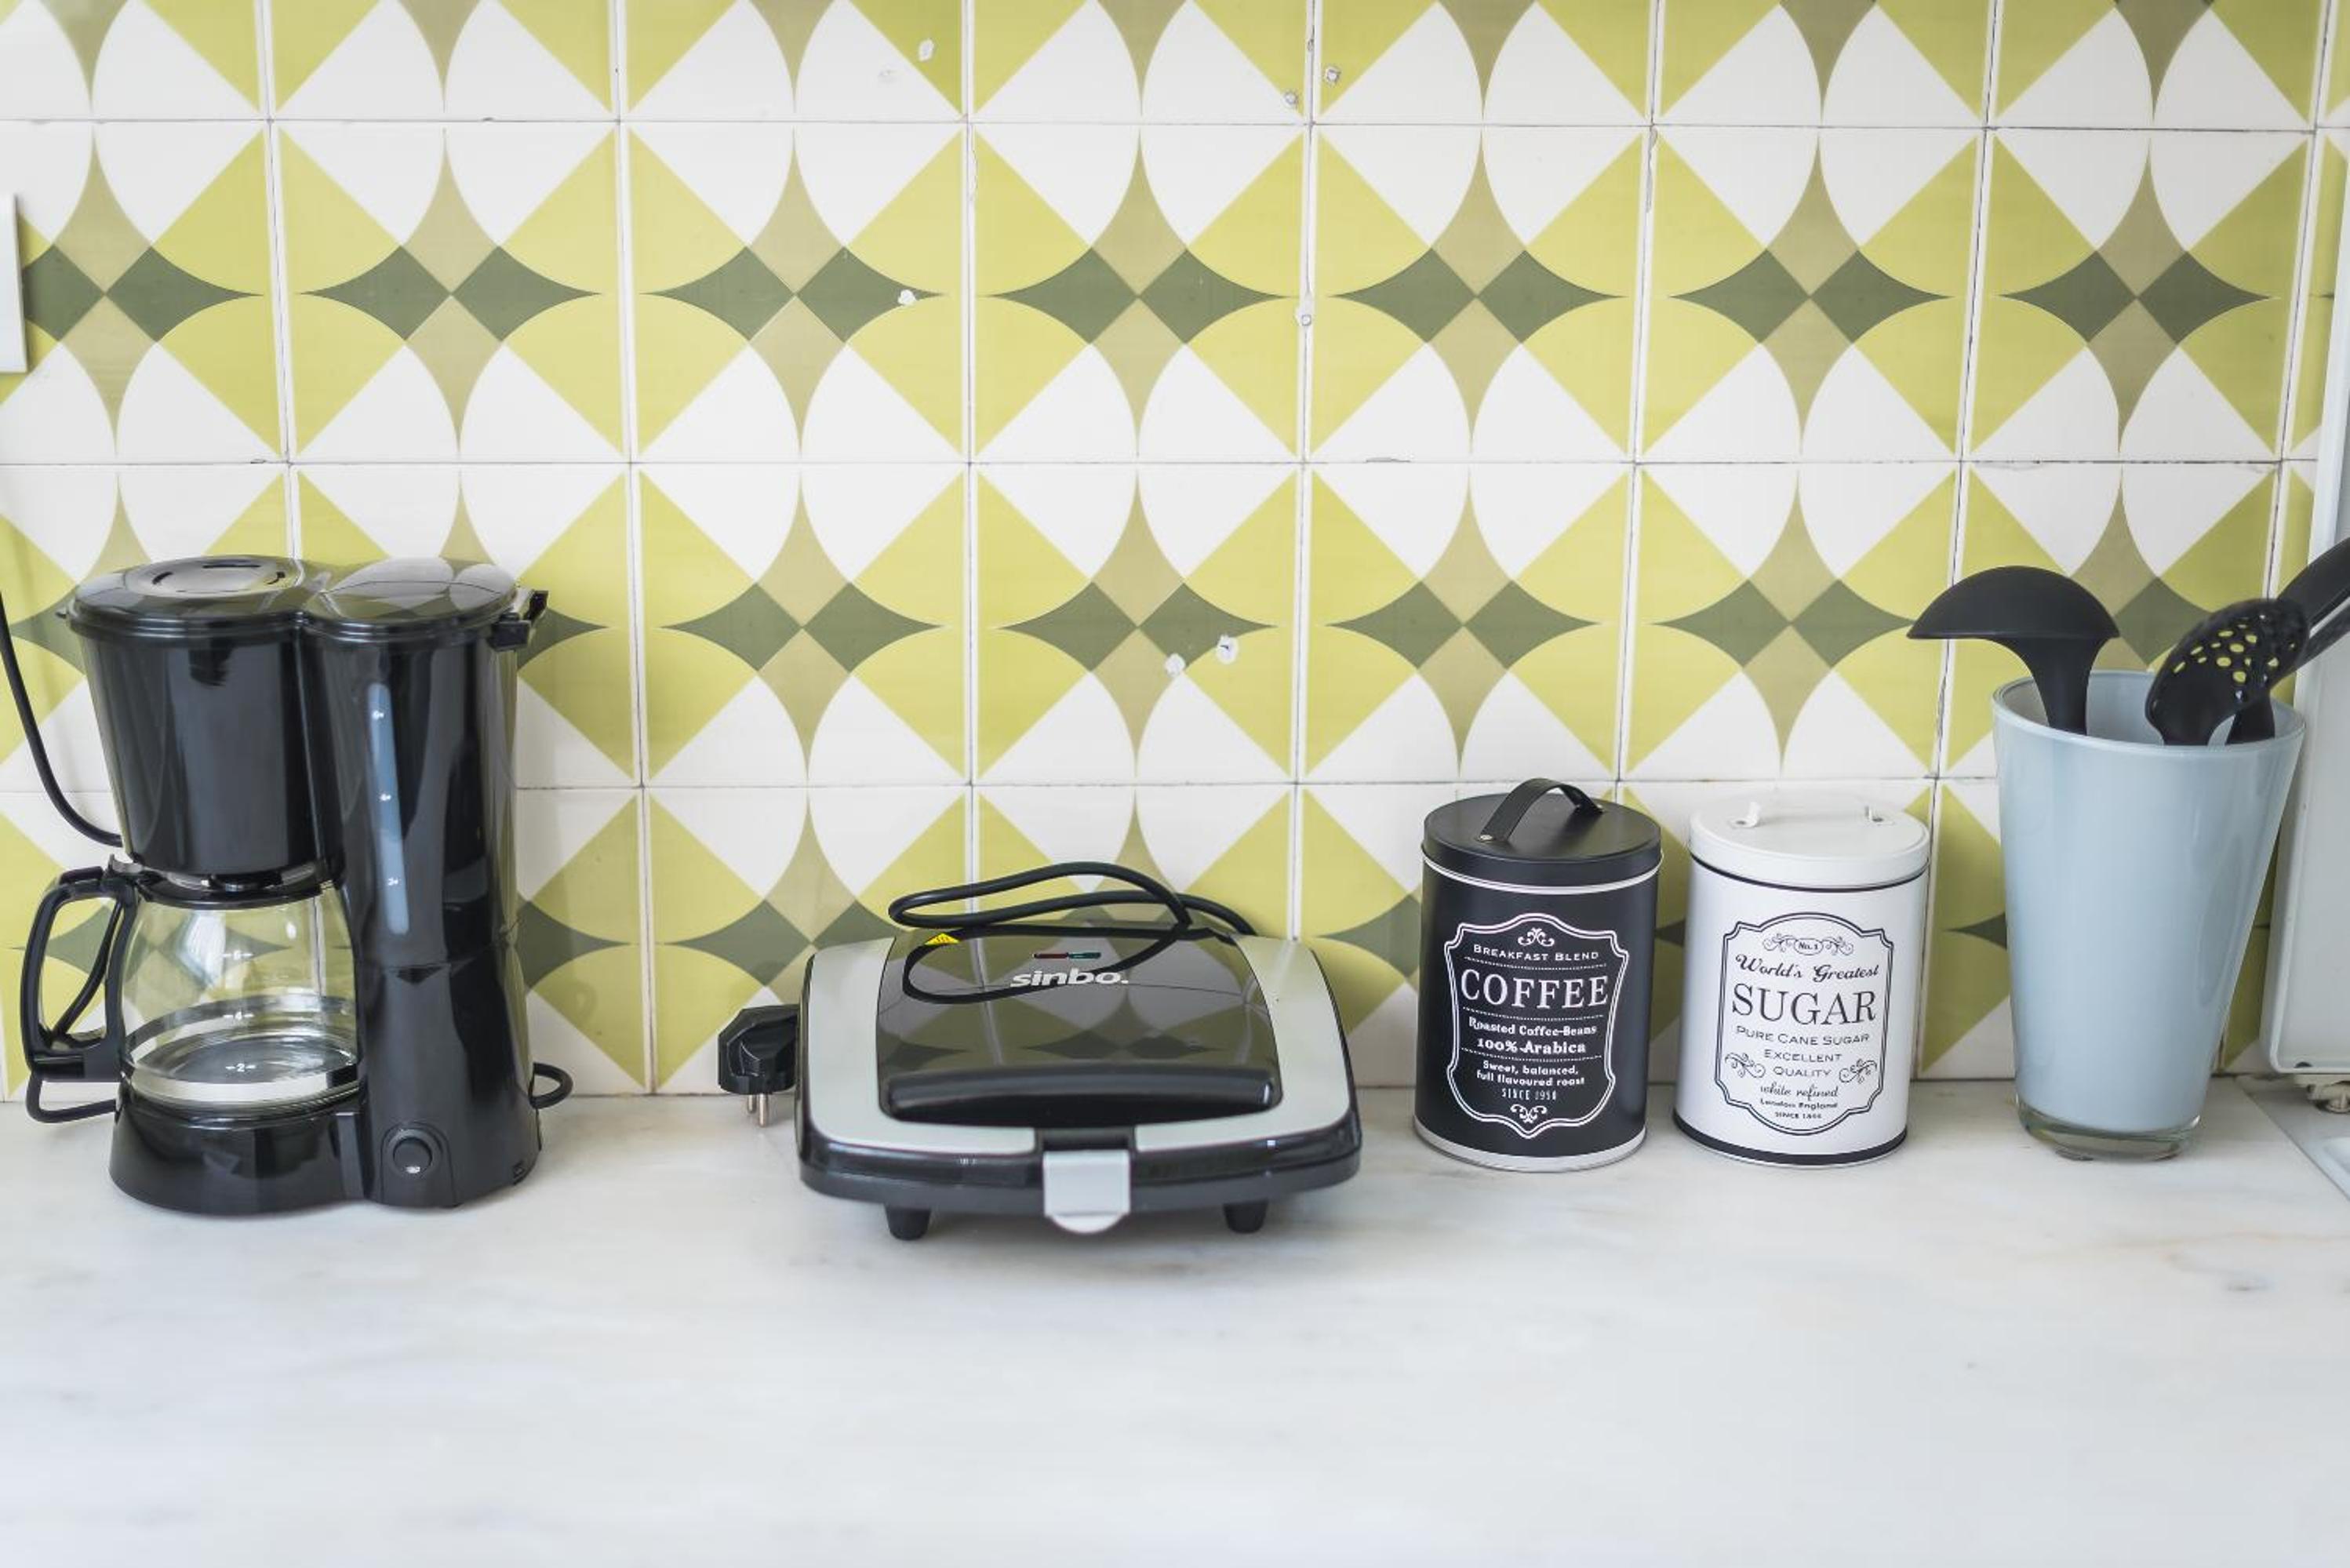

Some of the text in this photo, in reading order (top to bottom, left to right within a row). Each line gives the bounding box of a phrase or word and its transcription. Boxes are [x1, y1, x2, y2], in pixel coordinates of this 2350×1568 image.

[1473, 944, 1599, 961] BREAKFAST BLEND
[1735, 953, 1879, 983] World's Greatest
[1461, 968, 1608, 1009] COFFEE
[1732, 983, 1876, 1025] SUGAR
[1468, 1016, 1515, 1035] Roasted
[1736, 1025, 1870, 1046] PURE CANE SUGAR
[1477, 1038, 1586, 1055] 100% Arabica
[1763, 1048, 1843, 1063] EXCELLENT
[1476, 1069, 1585, 1086] full flavoured roast
[1773, 1065, 1832, 1078] QUALITY
[1501, 1087, 1530, 1101] SINCE
